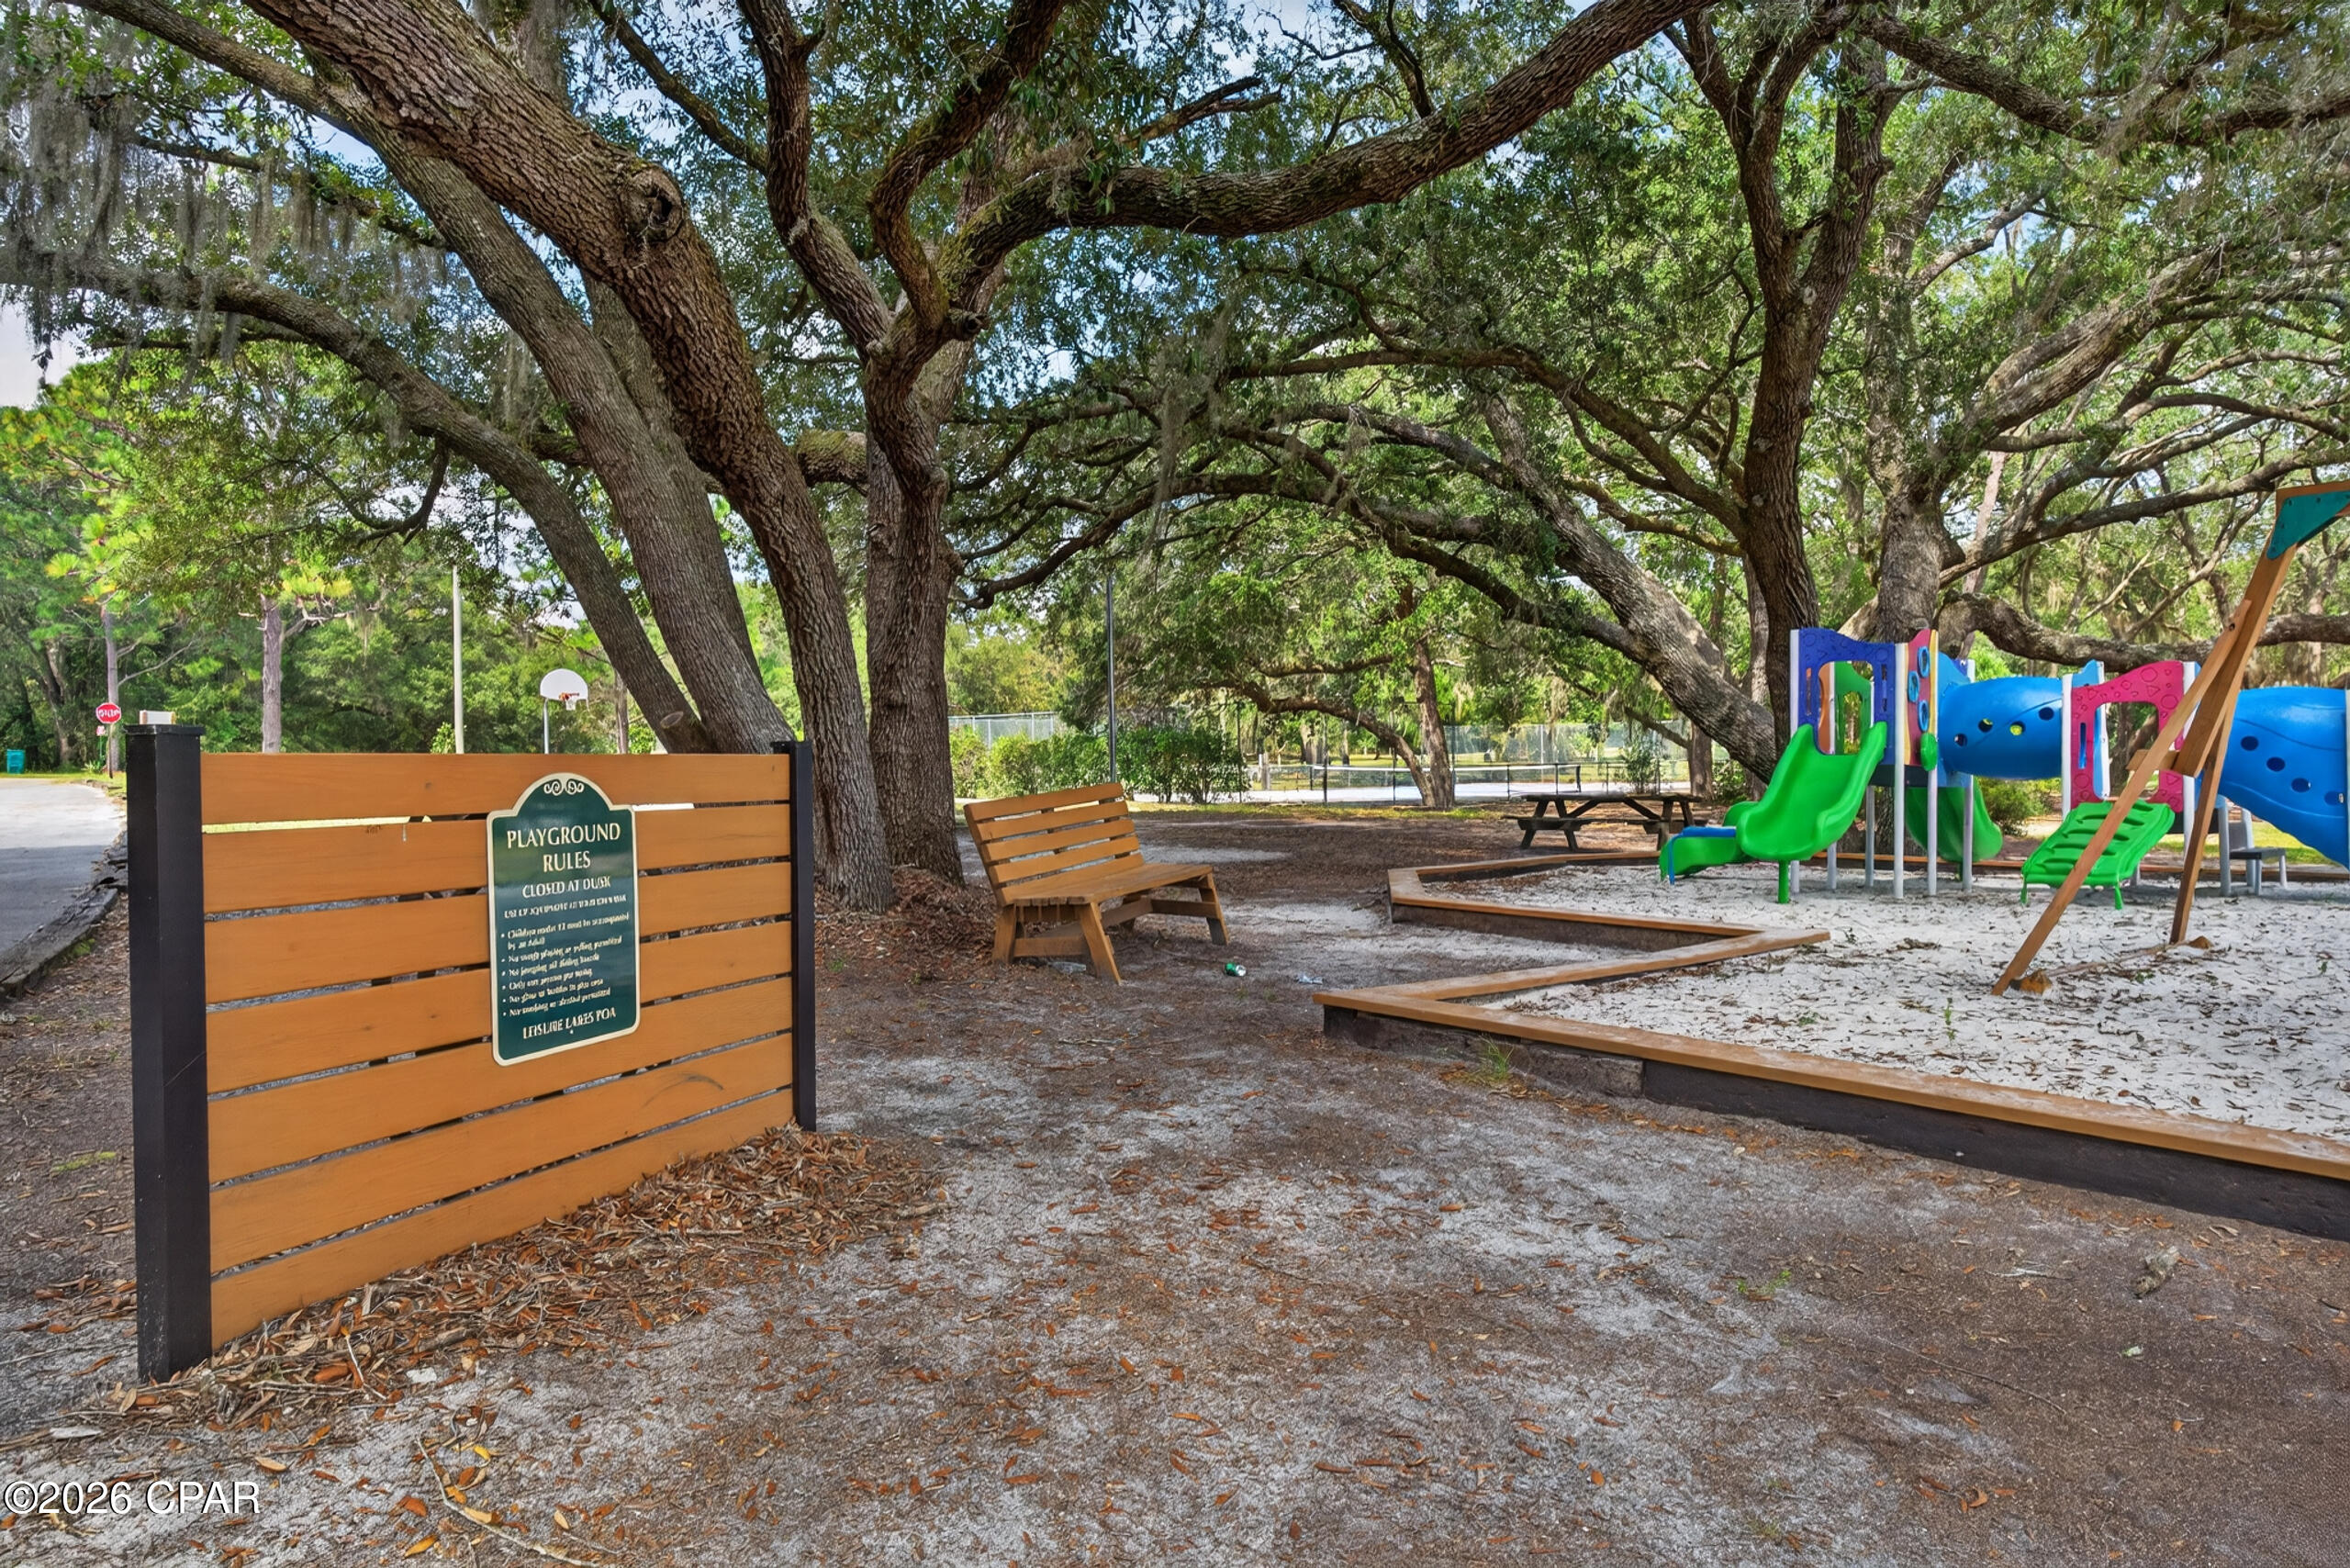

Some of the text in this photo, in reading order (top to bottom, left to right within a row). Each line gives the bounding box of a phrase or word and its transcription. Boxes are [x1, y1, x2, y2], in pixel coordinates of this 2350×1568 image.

[507, 823, 621, 849] PLAYGROUND
[543, 850, 591, 872] RULES
[521, 876, 610, 899] CLOSED AT DUSK
[596, 1007, 617, 1022] POA
